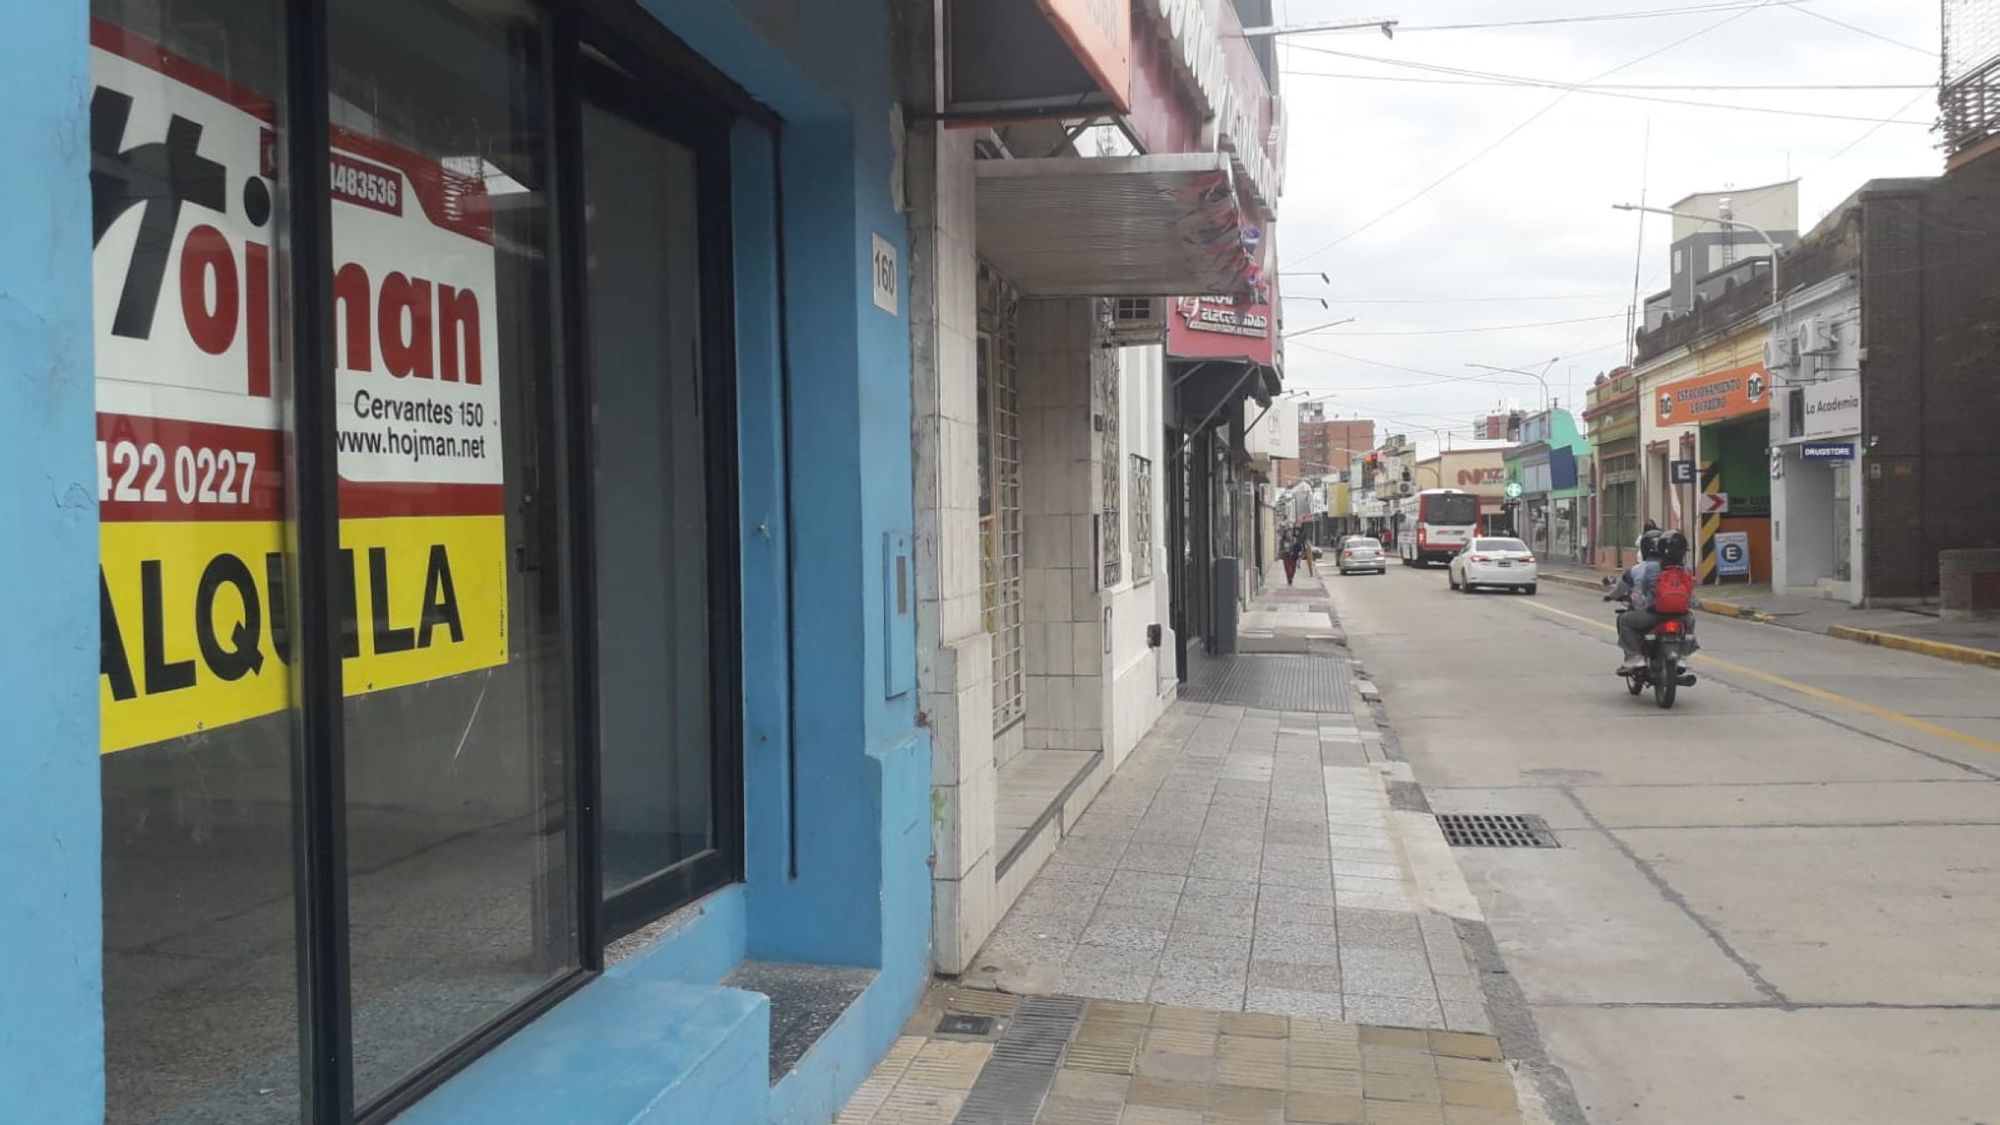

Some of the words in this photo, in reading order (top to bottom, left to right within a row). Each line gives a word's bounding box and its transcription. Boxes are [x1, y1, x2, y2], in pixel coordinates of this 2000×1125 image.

[875, 249, 895, 296] 160
[354, 389, 453, 425] Cervantes
[459, 401, 484, 427] 150
[1806, 401, 1815, 414] La
[1818, 394, 1859, 412] Academia
[336, 426, 485, 463] www.hojman.net
[1805, 447, 1850, 456] DRUGSTORE
[174, 445, 256, 505] 0227
[1678, 464, 1690, 480] E
[1726, 547, 1738, 560] E
